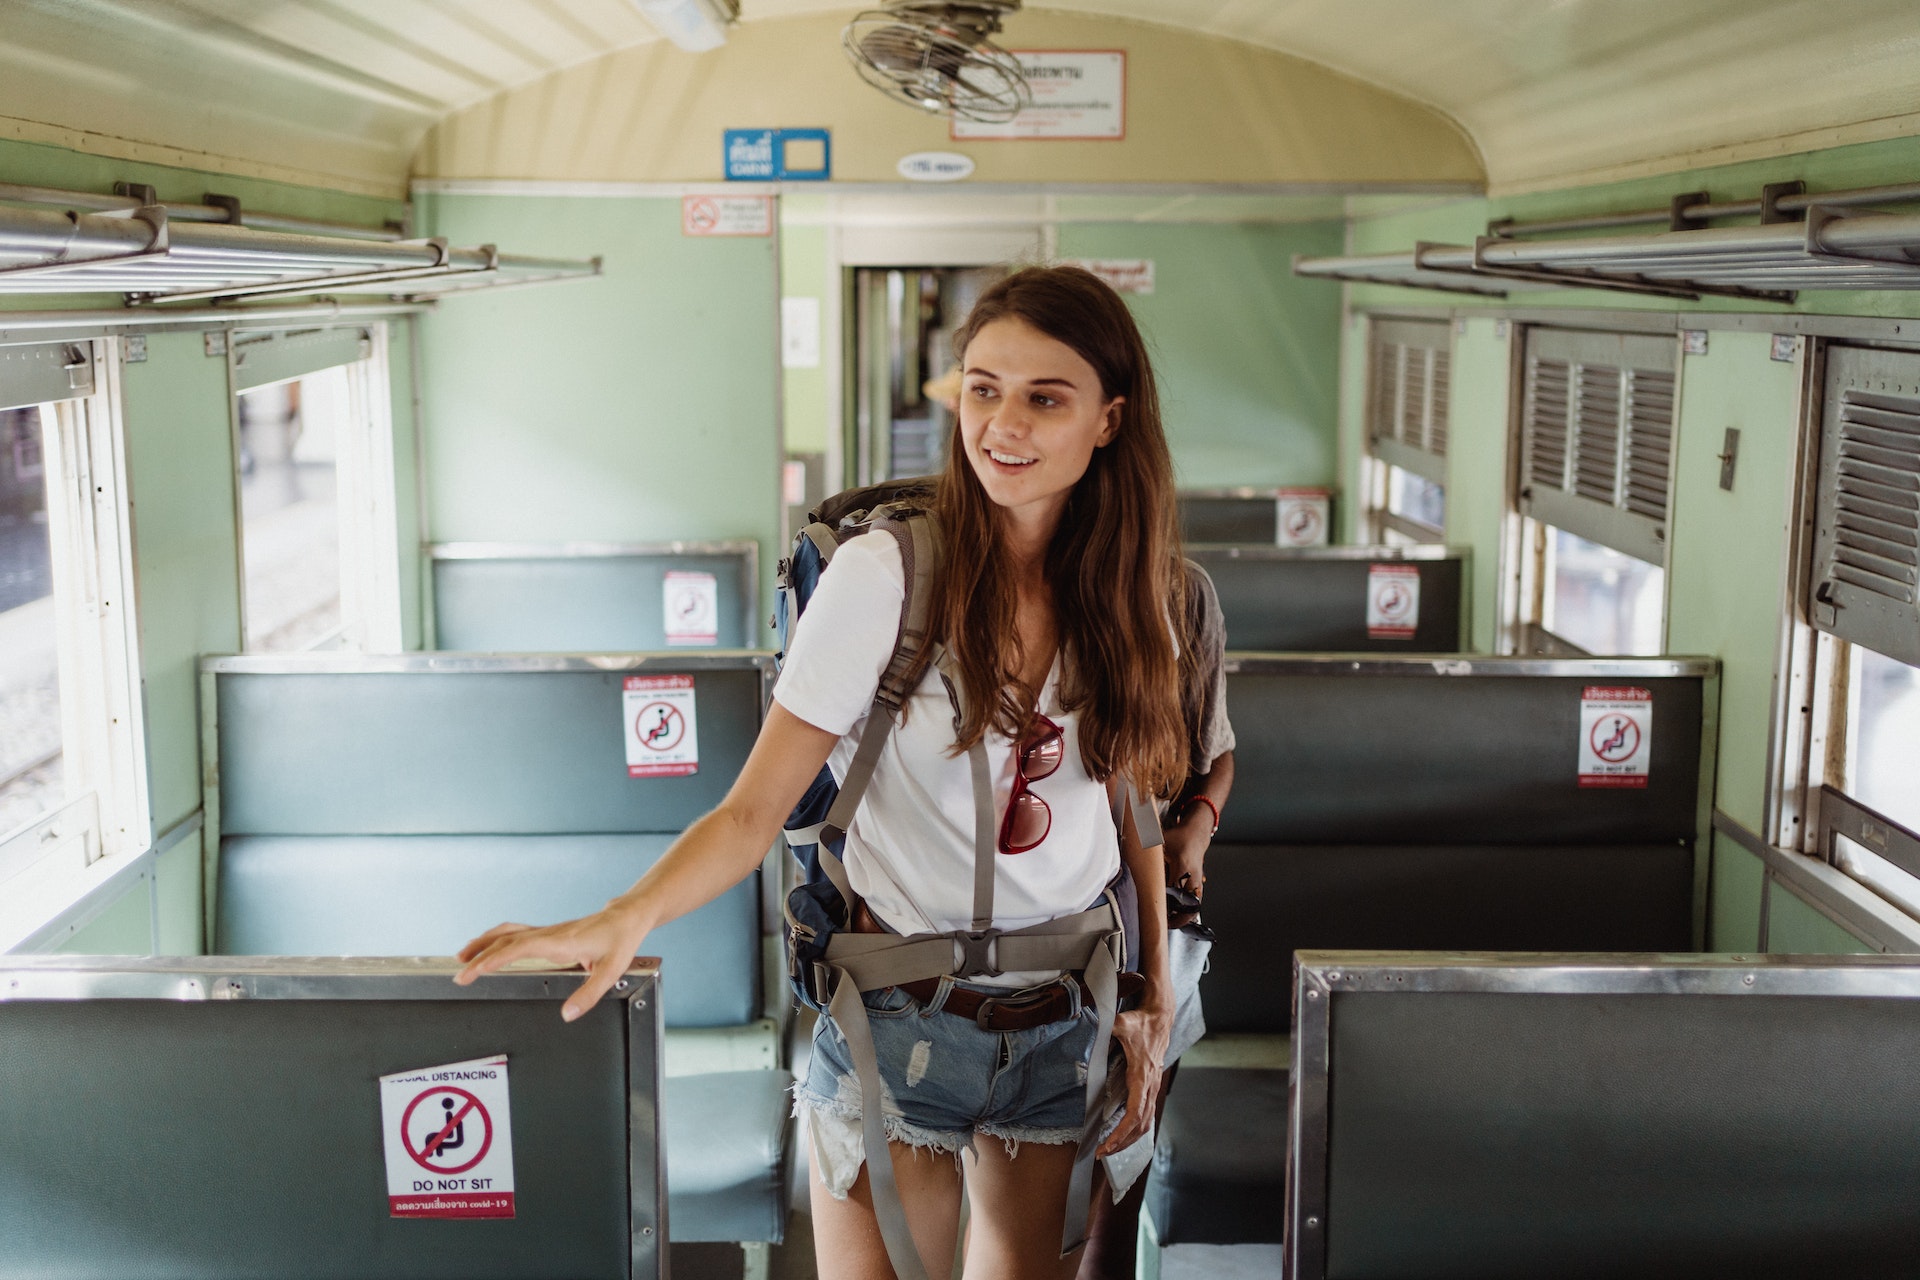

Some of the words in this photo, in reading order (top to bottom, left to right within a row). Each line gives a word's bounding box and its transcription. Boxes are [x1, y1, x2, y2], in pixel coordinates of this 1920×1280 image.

[432, 1070, 497, 1082] DISTANCING
[413, 1180, 434, 1192] DO
[438, 1179, 467, 1191] NOT
[471, 1178, 493, 1190] SIT
[396, 1197, 468, 1211] ลดความเสี่ยงจาก
[469, 1199, 508, 1209] covid-19
